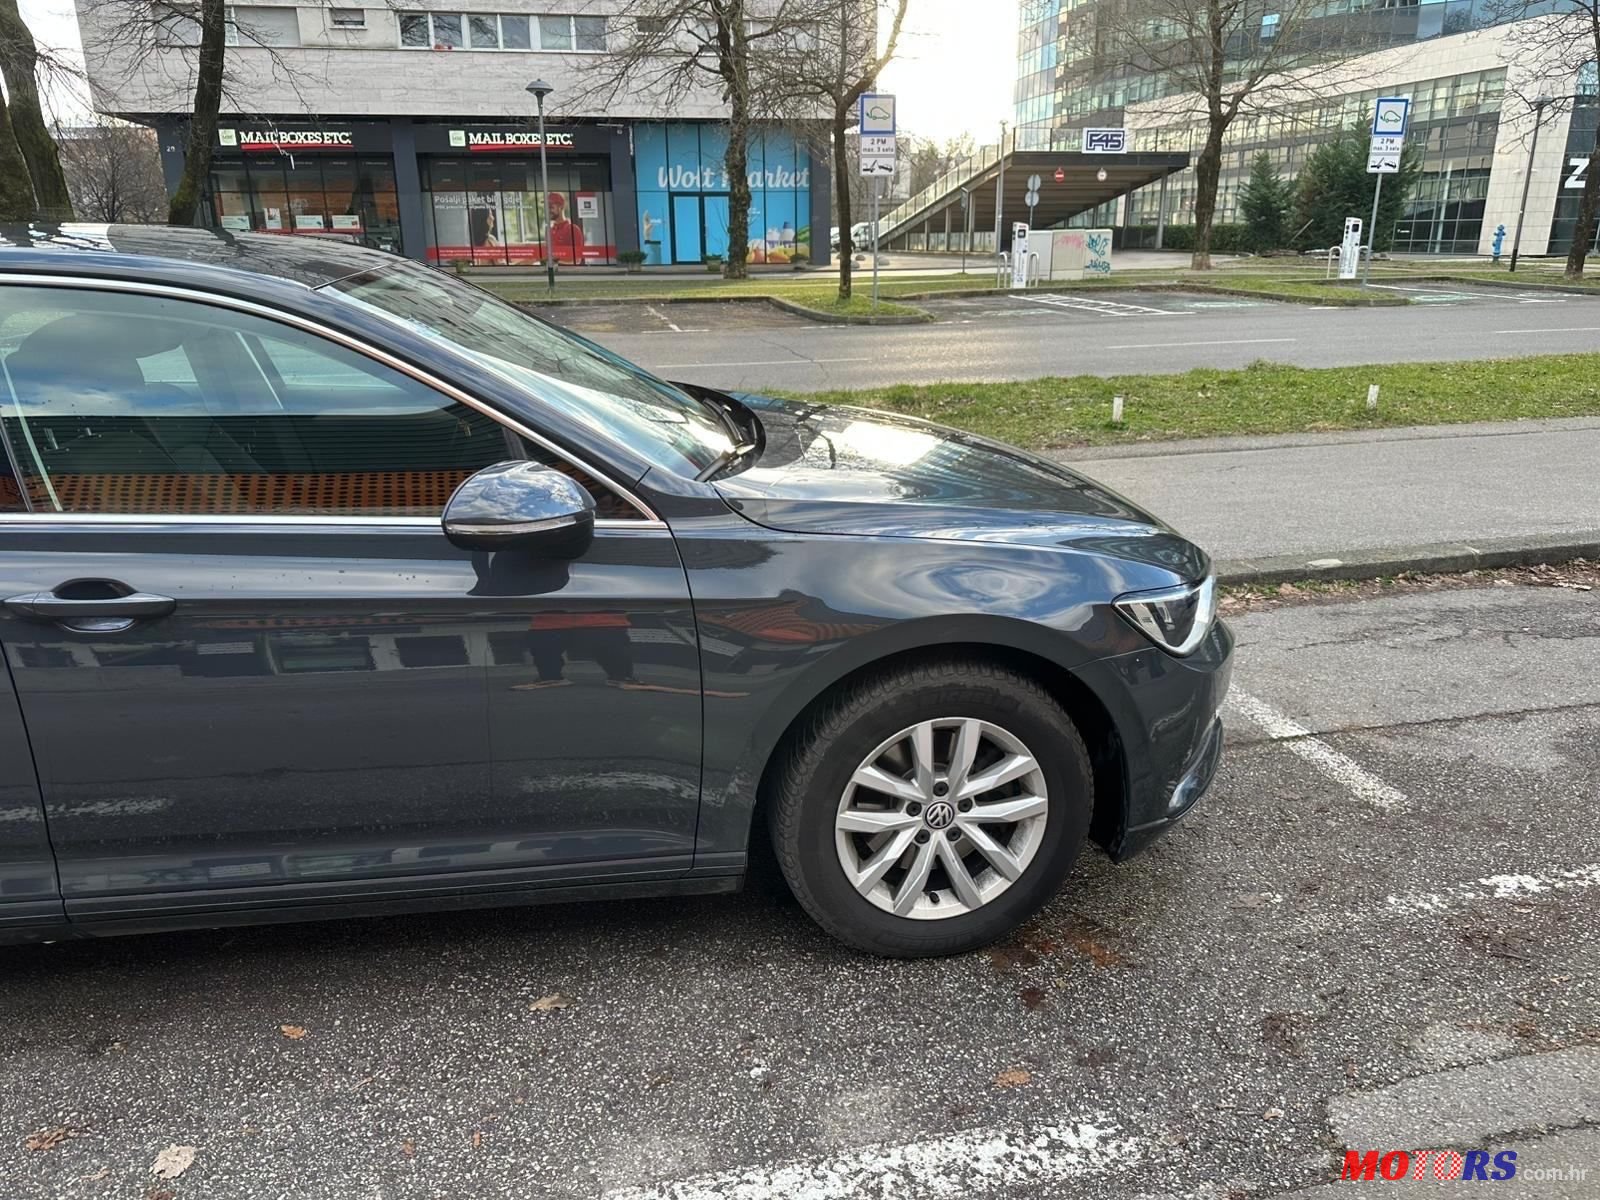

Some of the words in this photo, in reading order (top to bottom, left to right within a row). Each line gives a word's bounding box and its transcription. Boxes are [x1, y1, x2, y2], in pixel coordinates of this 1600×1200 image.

[240, 131, 278, 144] MAIL
[279, 131, 322, 144] BOXES
[468, 132, 504, 145] MAIL
[658, 165, 715, 188] Wolt
[1564, 158, 1590, 188] Z
